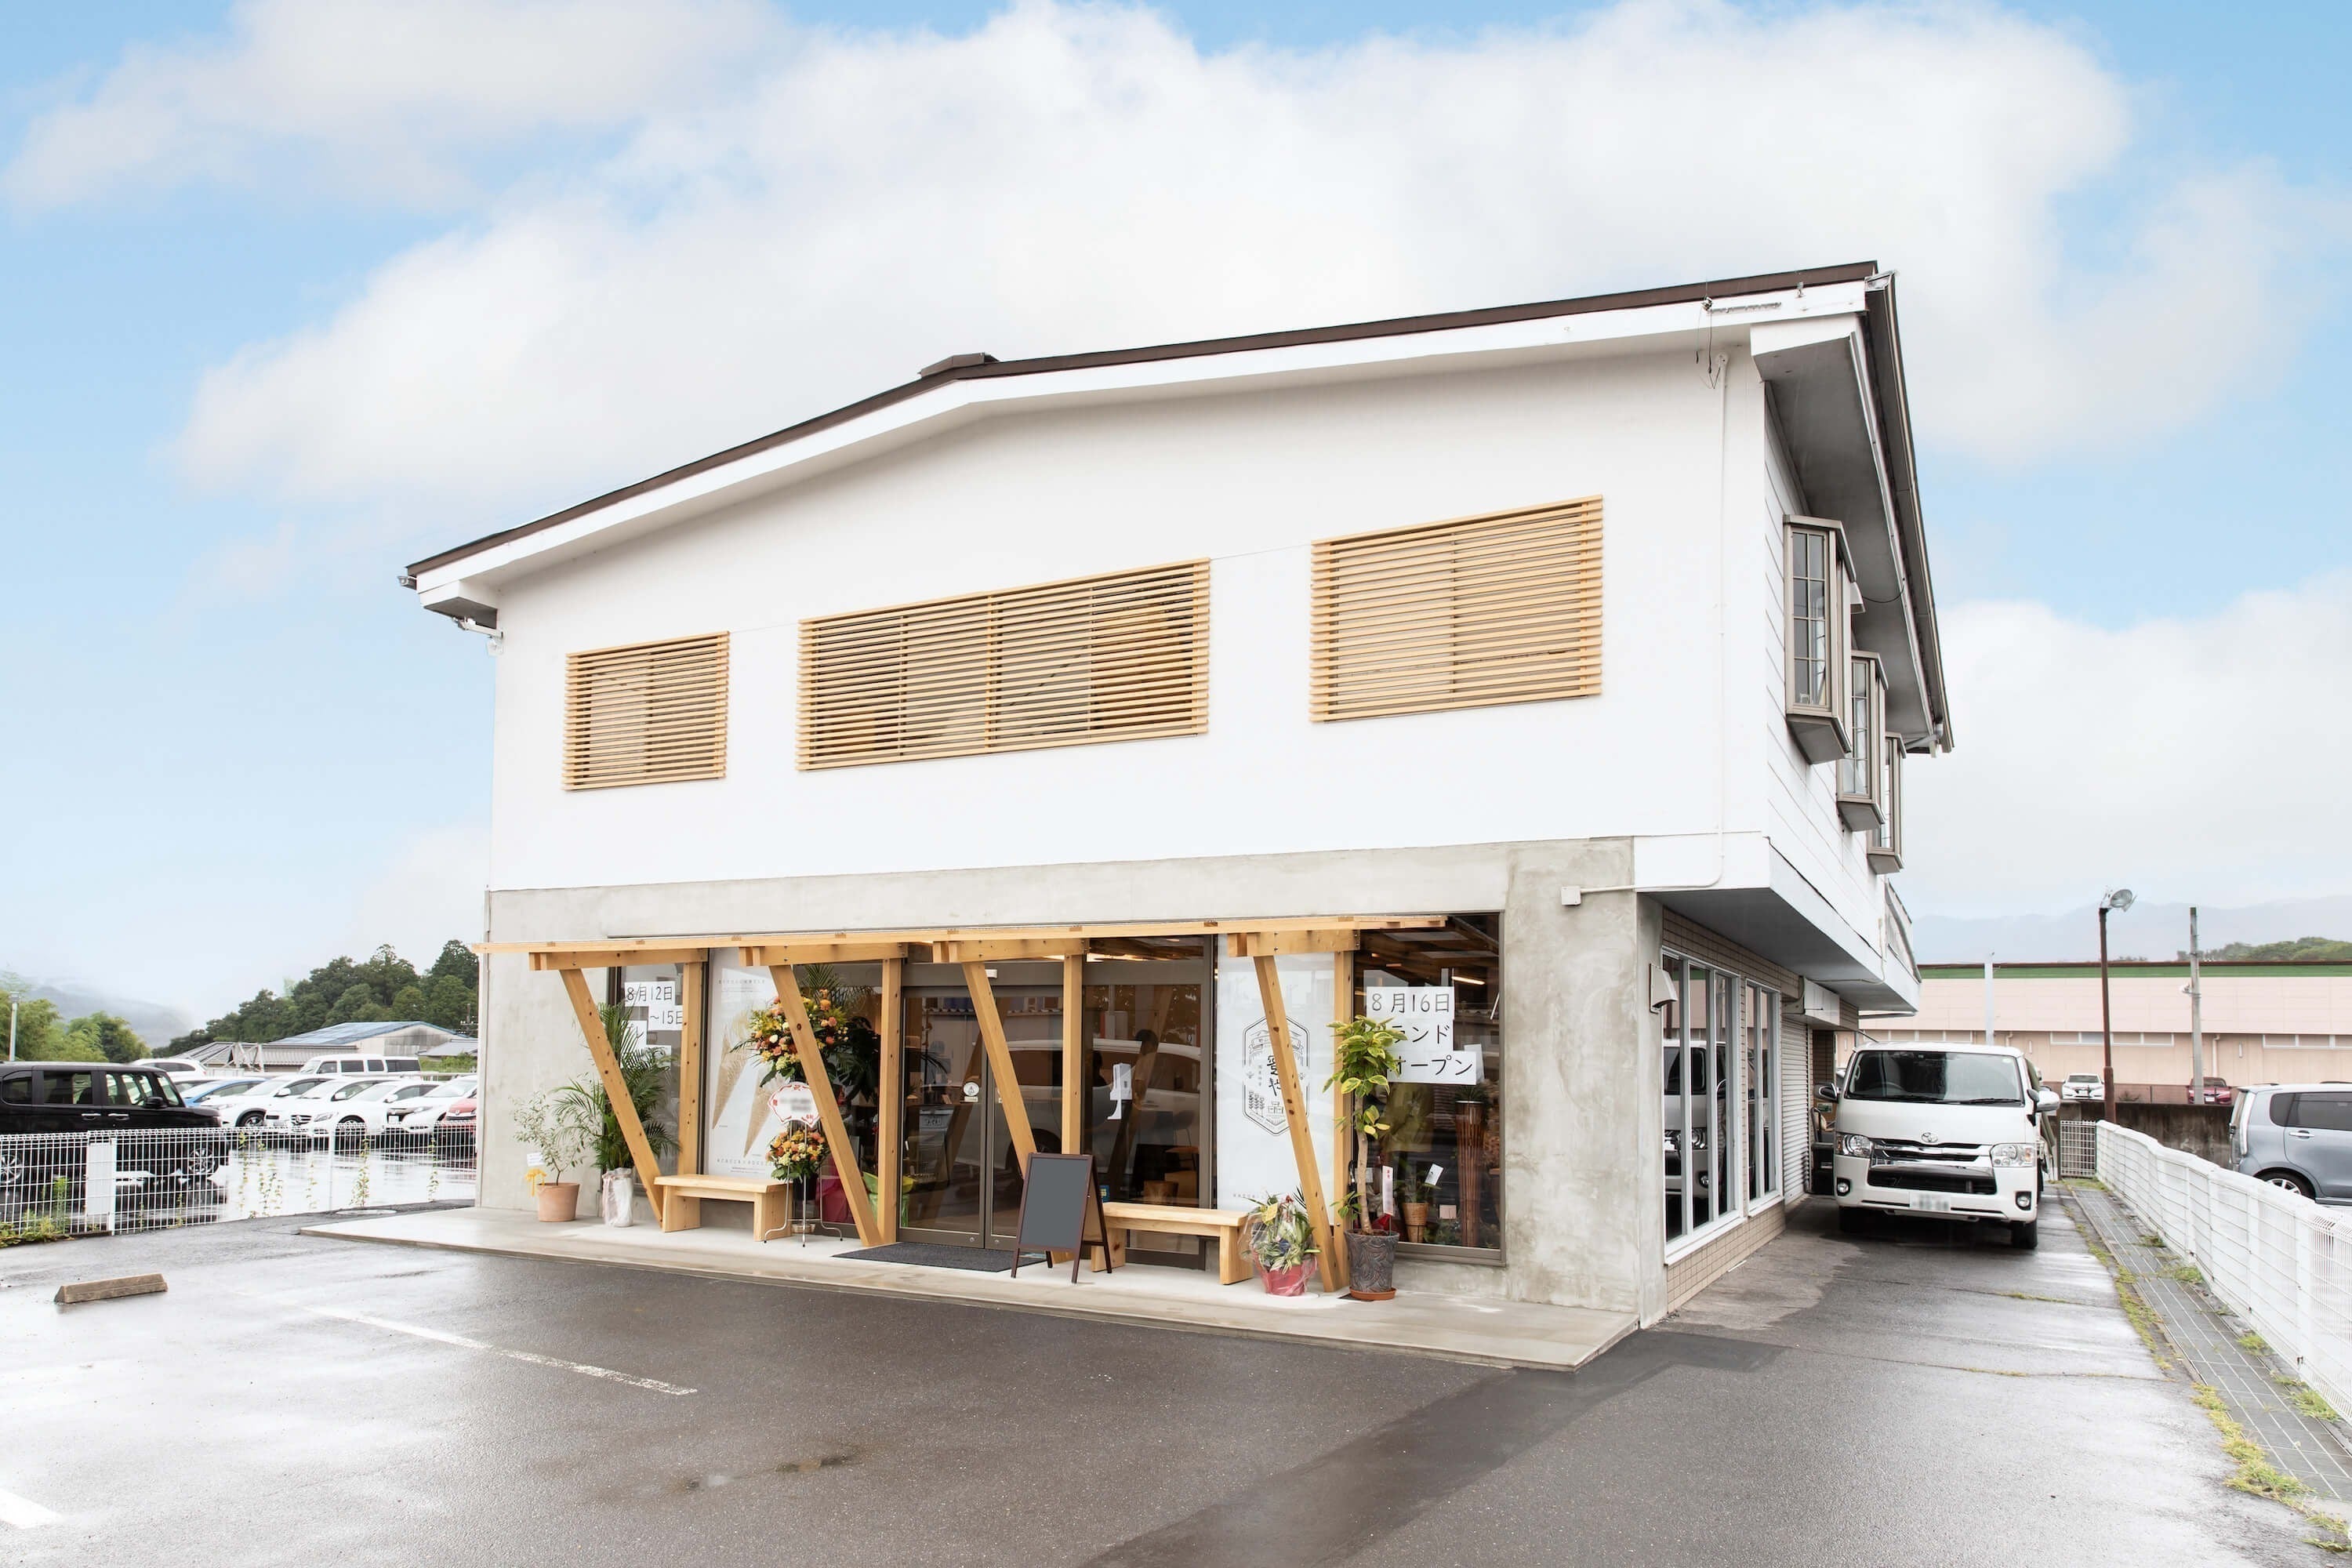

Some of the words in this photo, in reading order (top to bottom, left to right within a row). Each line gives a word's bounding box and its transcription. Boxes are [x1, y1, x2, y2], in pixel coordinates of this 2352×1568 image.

[626, 985, 673, 1002] 8月12日
[1372, 993, 1450, 1014] 8月16日
[1378, 1022, 1450, 1044] ランド
